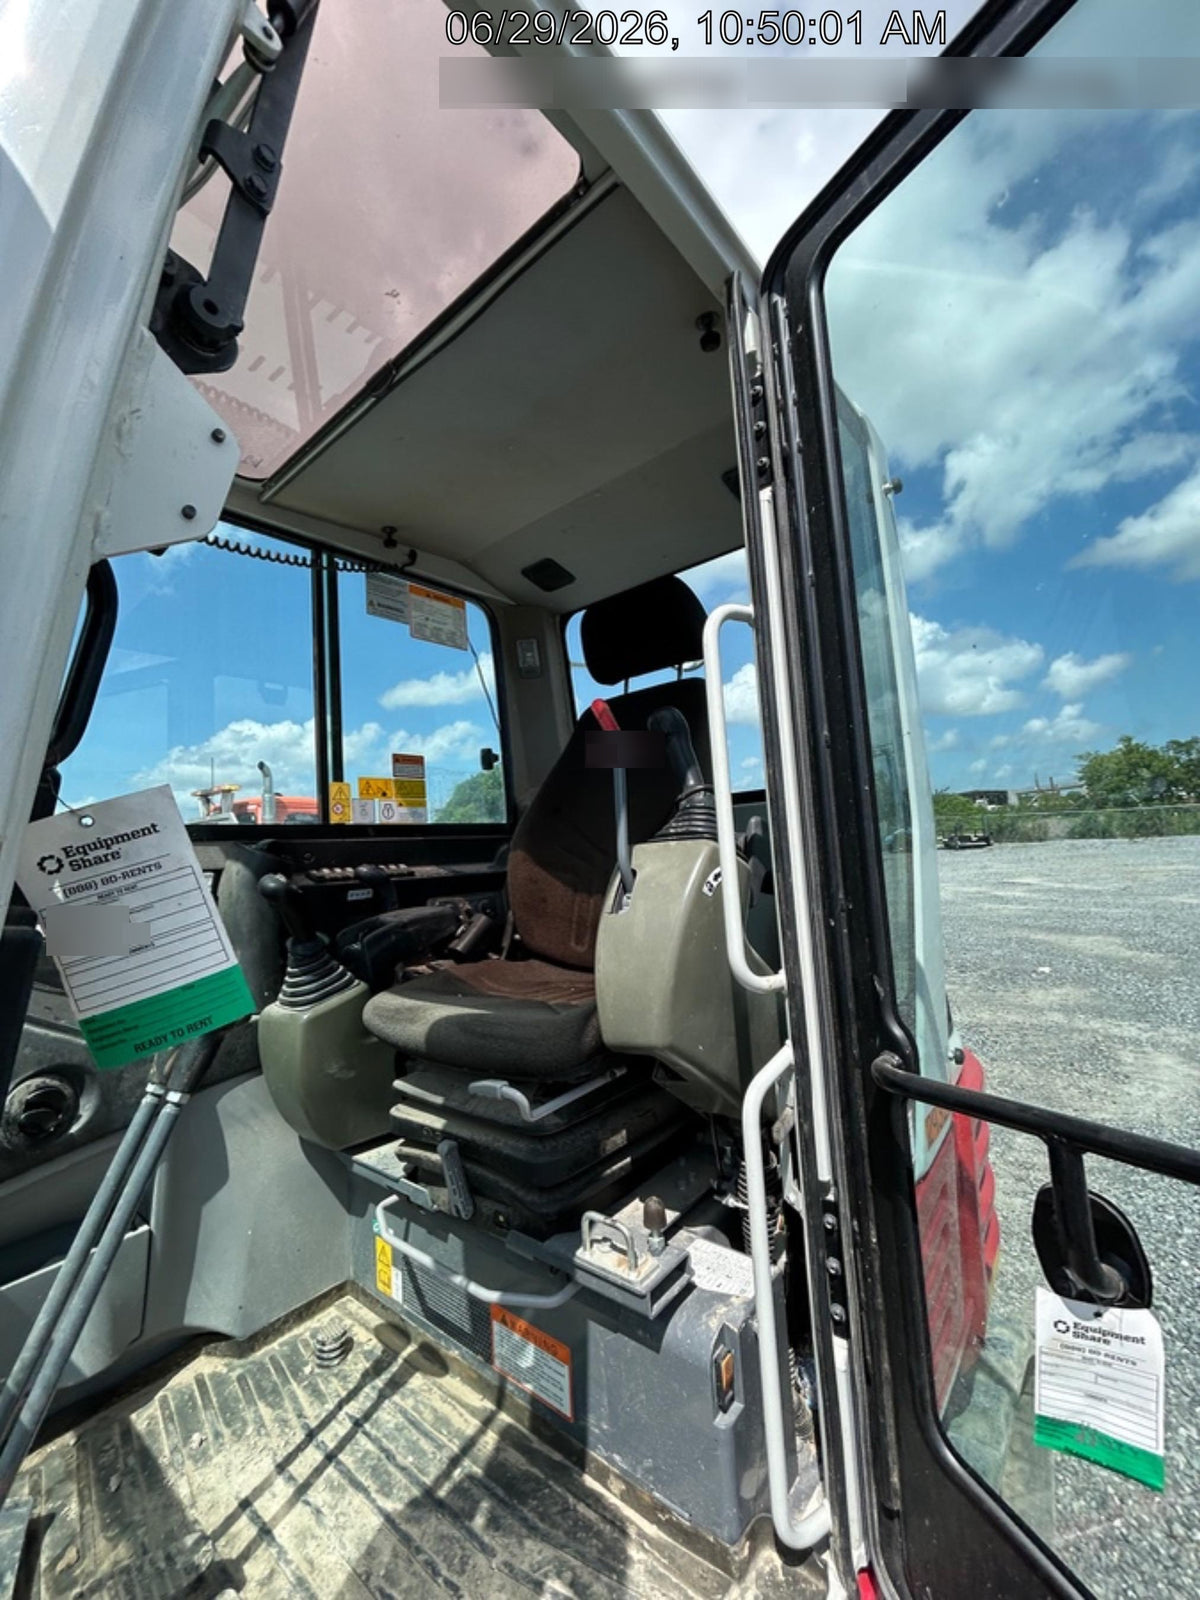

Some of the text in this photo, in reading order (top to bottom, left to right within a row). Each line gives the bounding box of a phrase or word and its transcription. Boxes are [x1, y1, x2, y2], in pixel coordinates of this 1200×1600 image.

[61, 822, 160, 859] Equipment
[68, 849, 122, 872] Share
[134, 1035, 169, 1053] READY
[170, 1027, 185, 1039] TO
[187, 1015, 214, 1033] RENT
[1072, 1330, 1111, 1346] Share
[1073, 1321, 1146, 1345] Equipment
